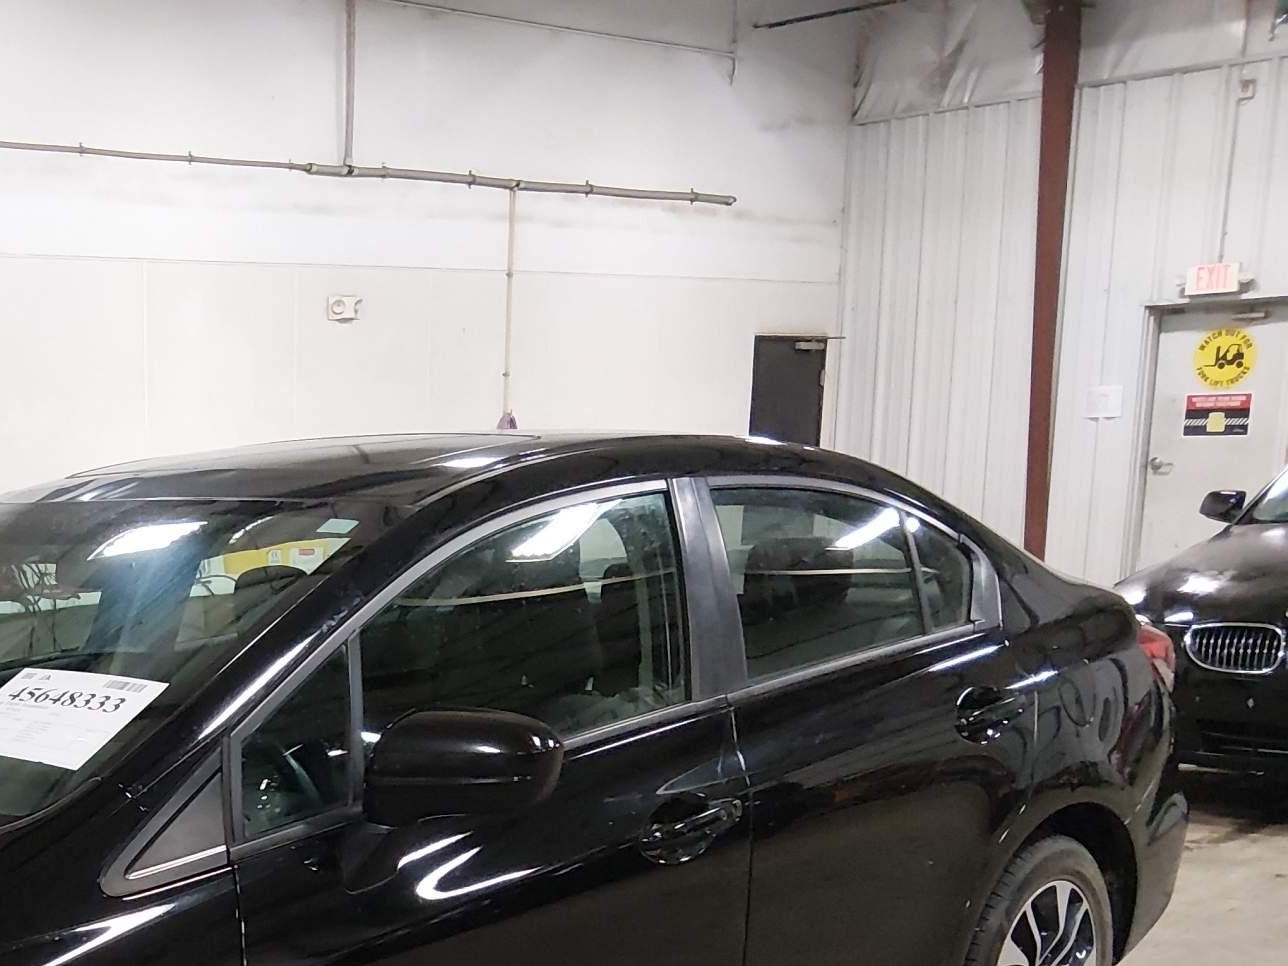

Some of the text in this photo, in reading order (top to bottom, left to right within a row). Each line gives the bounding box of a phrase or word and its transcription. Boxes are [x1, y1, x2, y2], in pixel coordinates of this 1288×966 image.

[1195, 264, 1231, 290] EXIT
[1198, 329, 1223, 351] WATCH
[8, 686, 126, 713] 45648333
